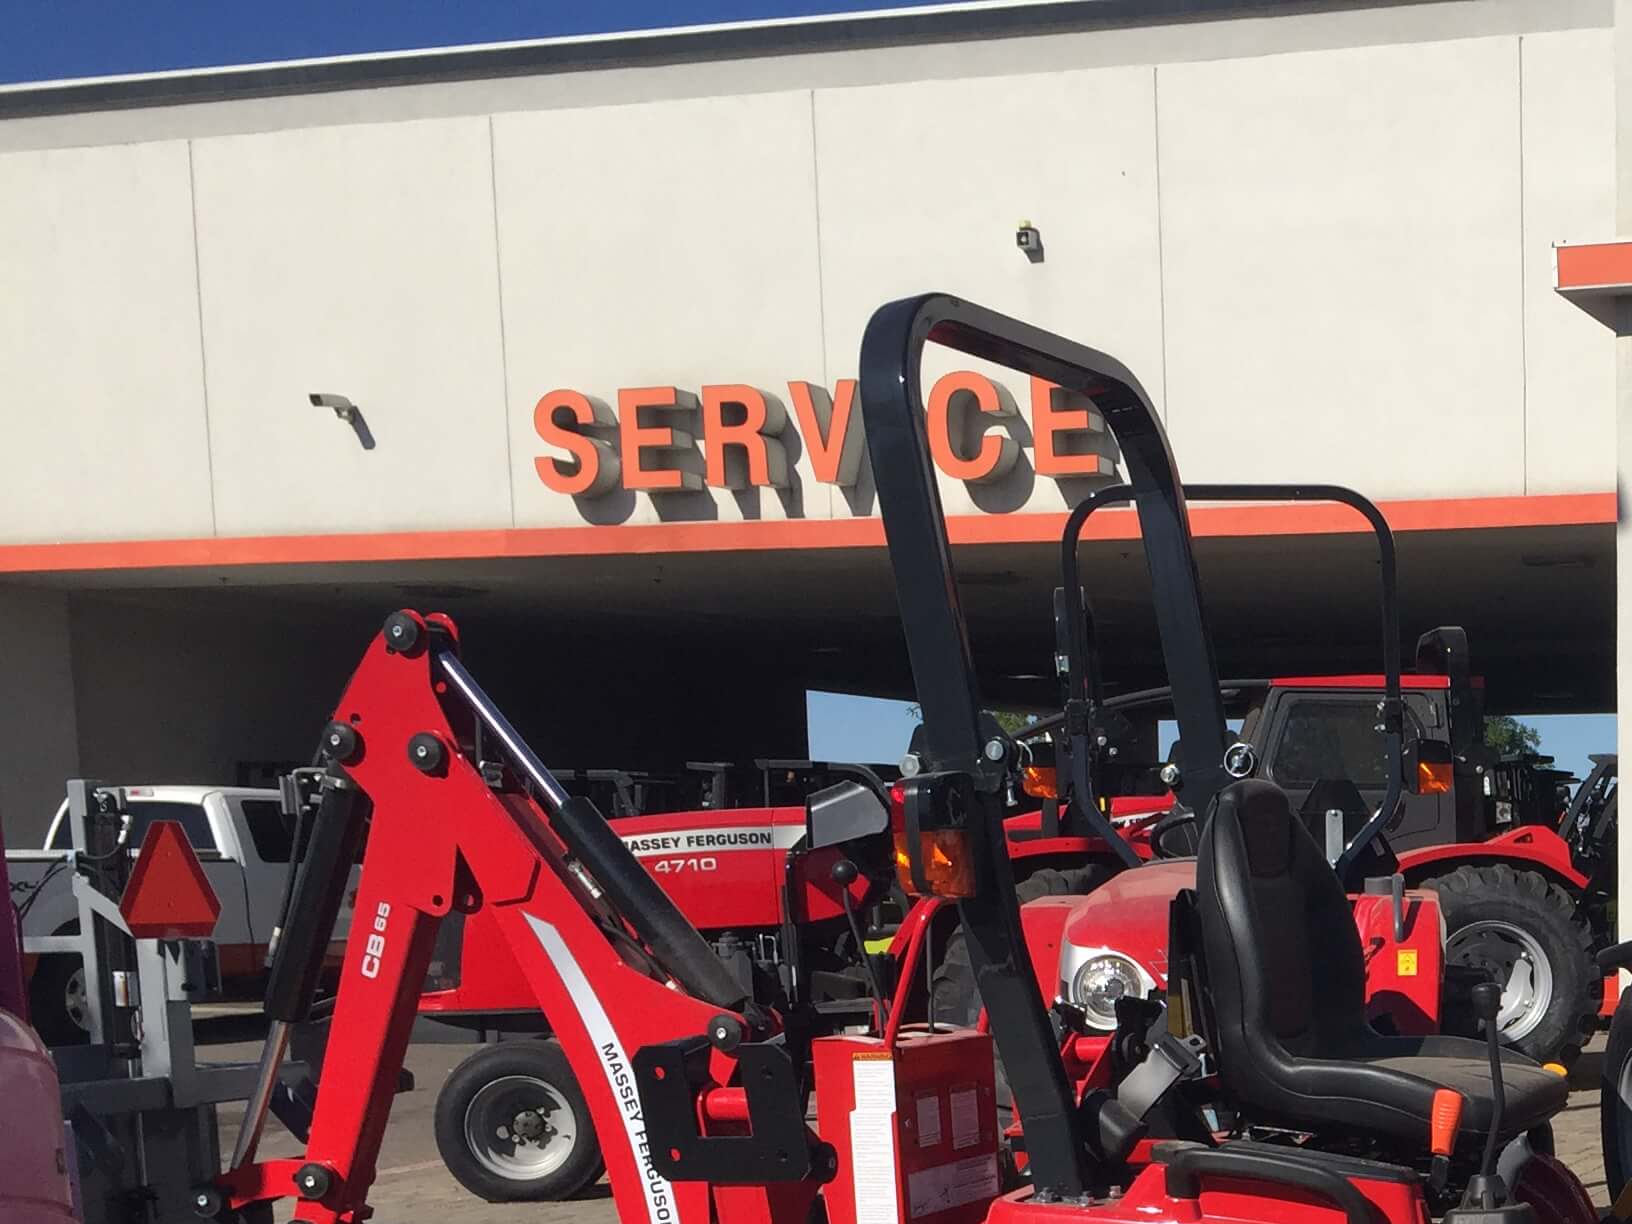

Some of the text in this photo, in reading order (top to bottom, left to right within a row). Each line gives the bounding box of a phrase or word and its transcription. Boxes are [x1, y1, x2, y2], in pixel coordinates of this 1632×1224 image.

[534, 371, 1104, 495] SERVCE
[654, 857, 717, 874] 4710
[687, 832, 772, 847] FERGUSON
[361, 901, 391, 979] CB 65
[602, 1042, 645, 1121] MASSEY
